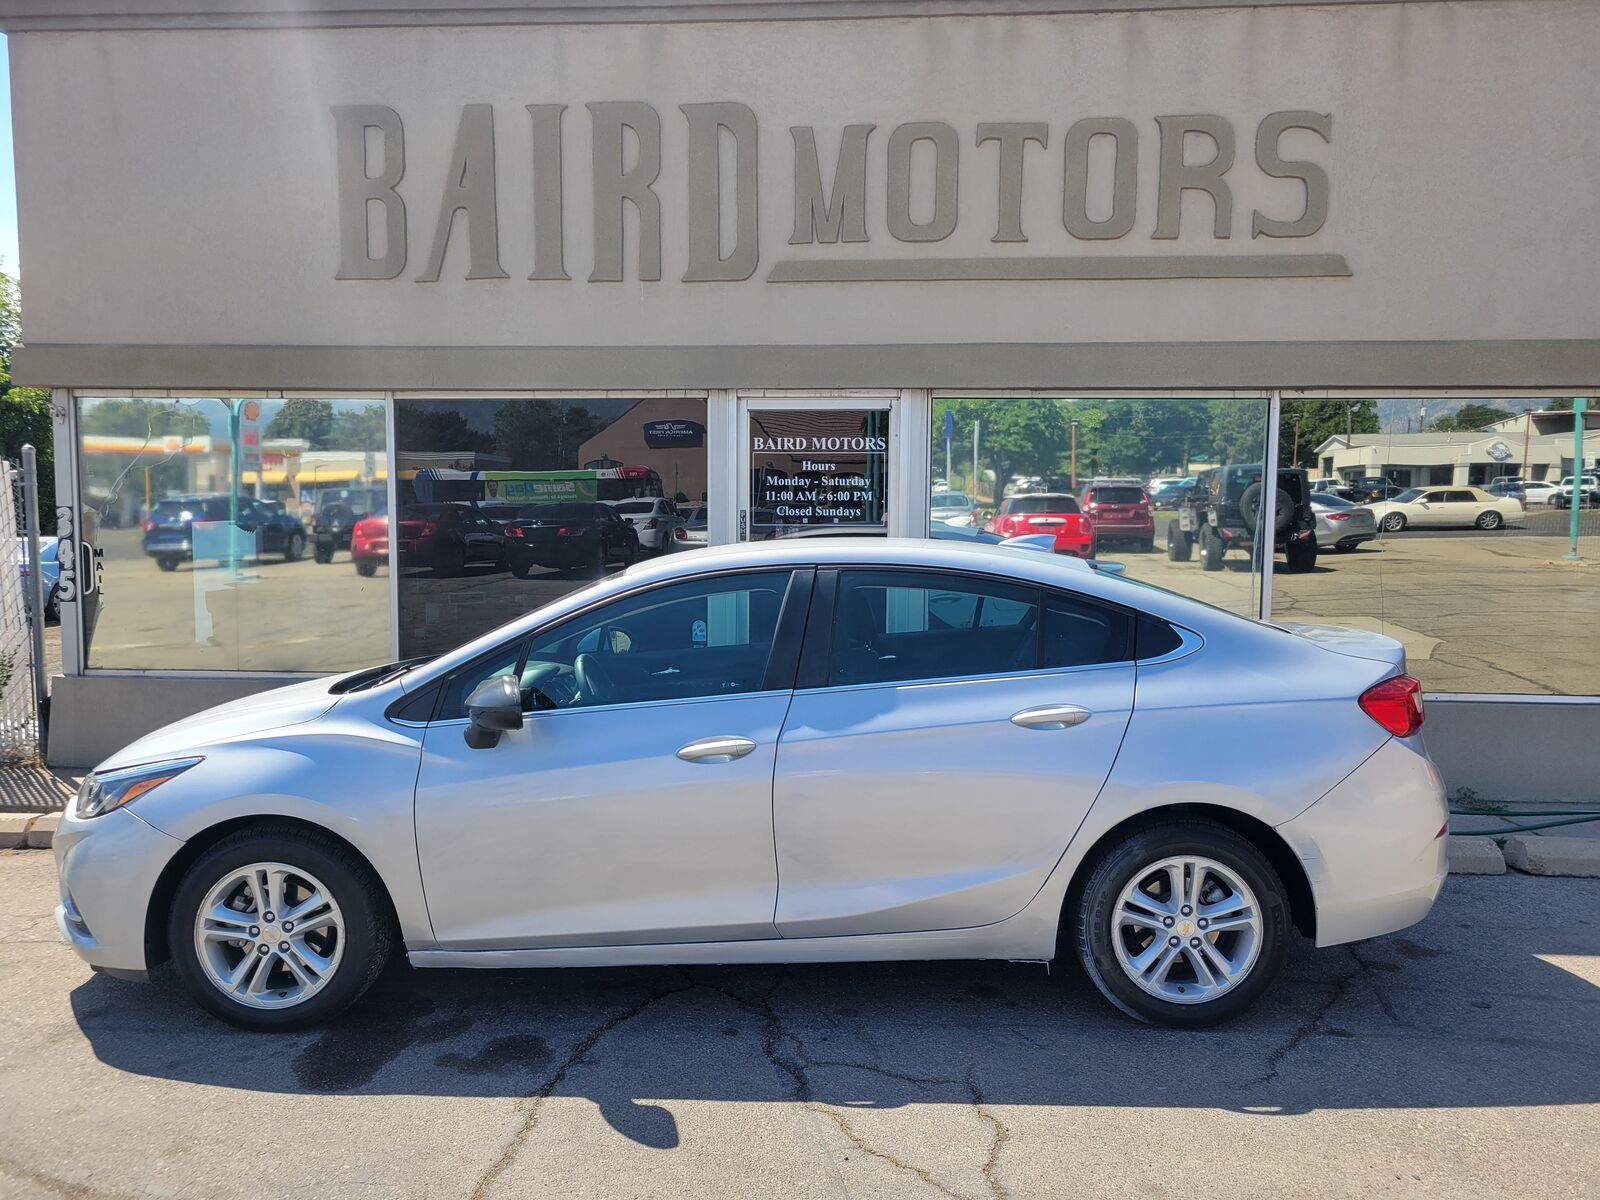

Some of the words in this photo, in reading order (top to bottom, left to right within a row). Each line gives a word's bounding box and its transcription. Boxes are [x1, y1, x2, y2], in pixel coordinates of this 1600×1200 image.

[329, 102, 759, 283] BAIRD
[788, 110, 1332, 244] MOTORS
[753, 437, 807, 450] BAIRD
[811, 437, 886, 450] MOTORS
[802, 461, 836, 471] Hours
[766, 476, 811, 487] Monday
[821, 476, 871, 488] Saturday
[765, 491, 793, 501] 11:00
[795, 491, 816, 501] AM
[826, 491, 849, 501] 6:00
[853, 491, 873, 501] PM
[776, 506, 812, 516] Closed
[815, 506, 861, 518] Sundays
[94, 548, 104, 595] MAIL
